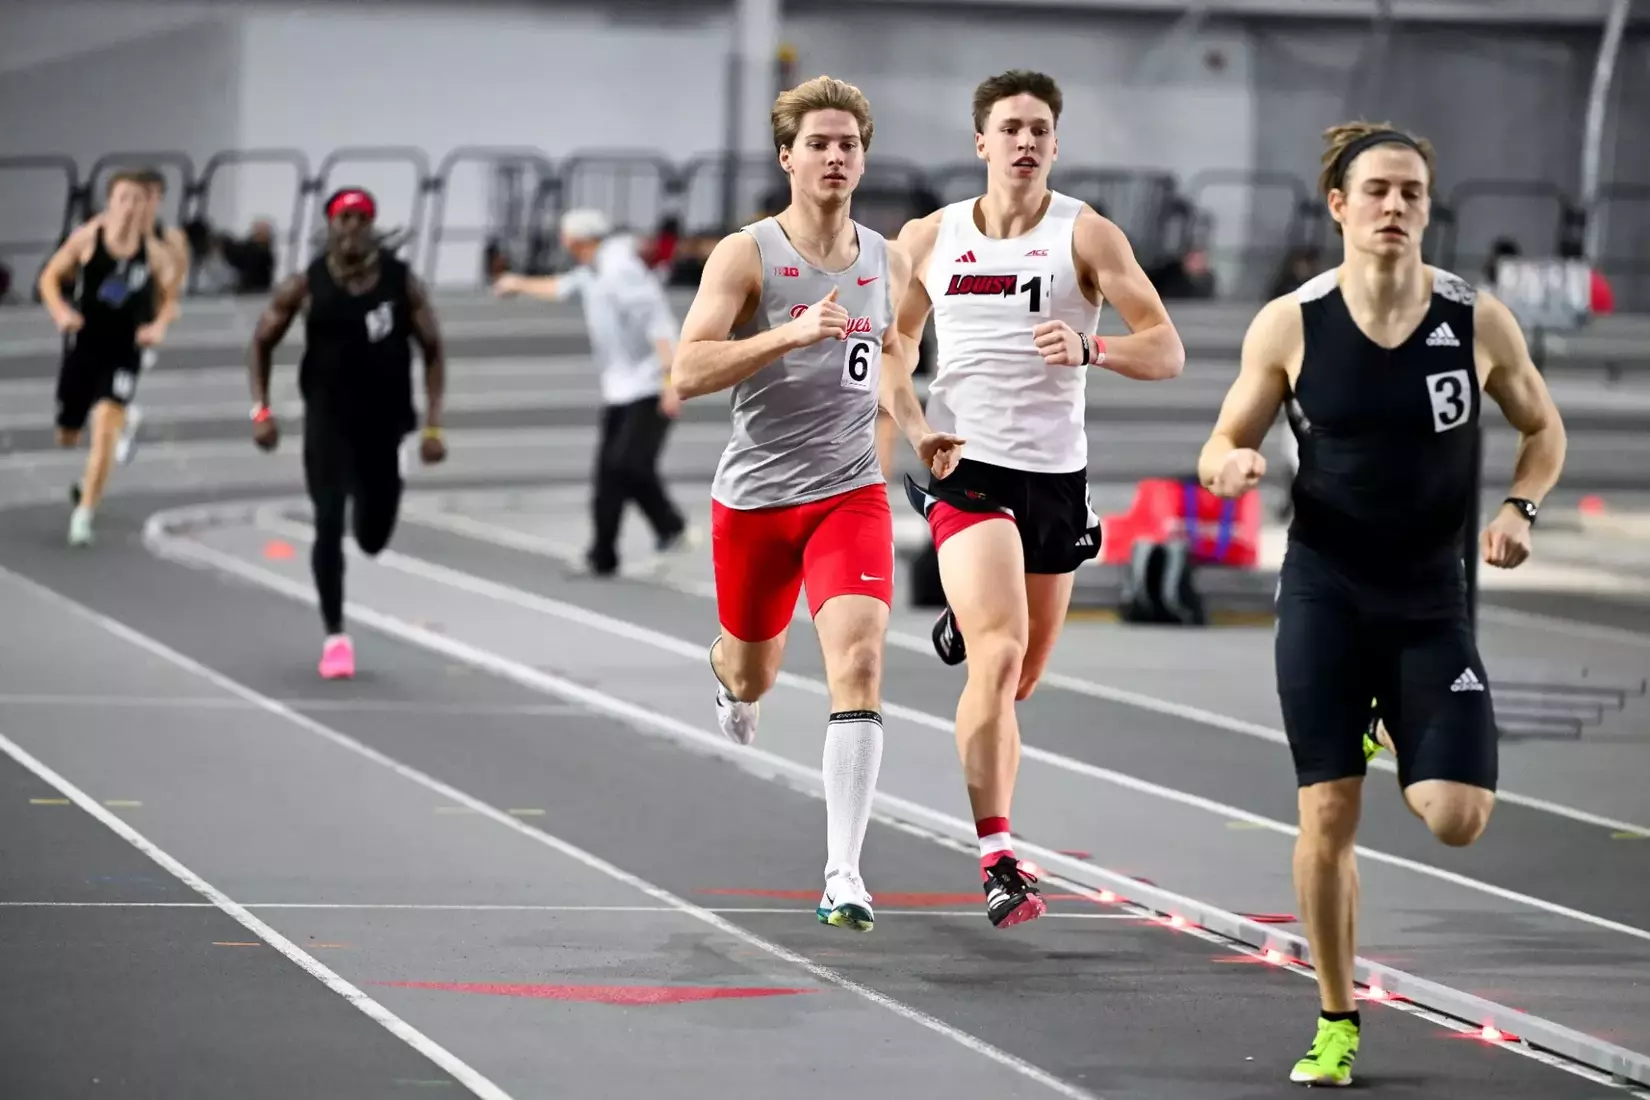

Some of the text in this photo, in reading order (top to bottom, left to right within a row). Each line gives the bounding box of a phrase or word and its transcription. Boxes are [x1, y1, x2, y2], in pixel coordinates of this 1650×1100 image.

[1025, 249, 1050, 257] ACC
[1020, 276, 1042, 313] 1
[848, 342, 870, 382] 6
[1435, 376, 1465, 425] 3
